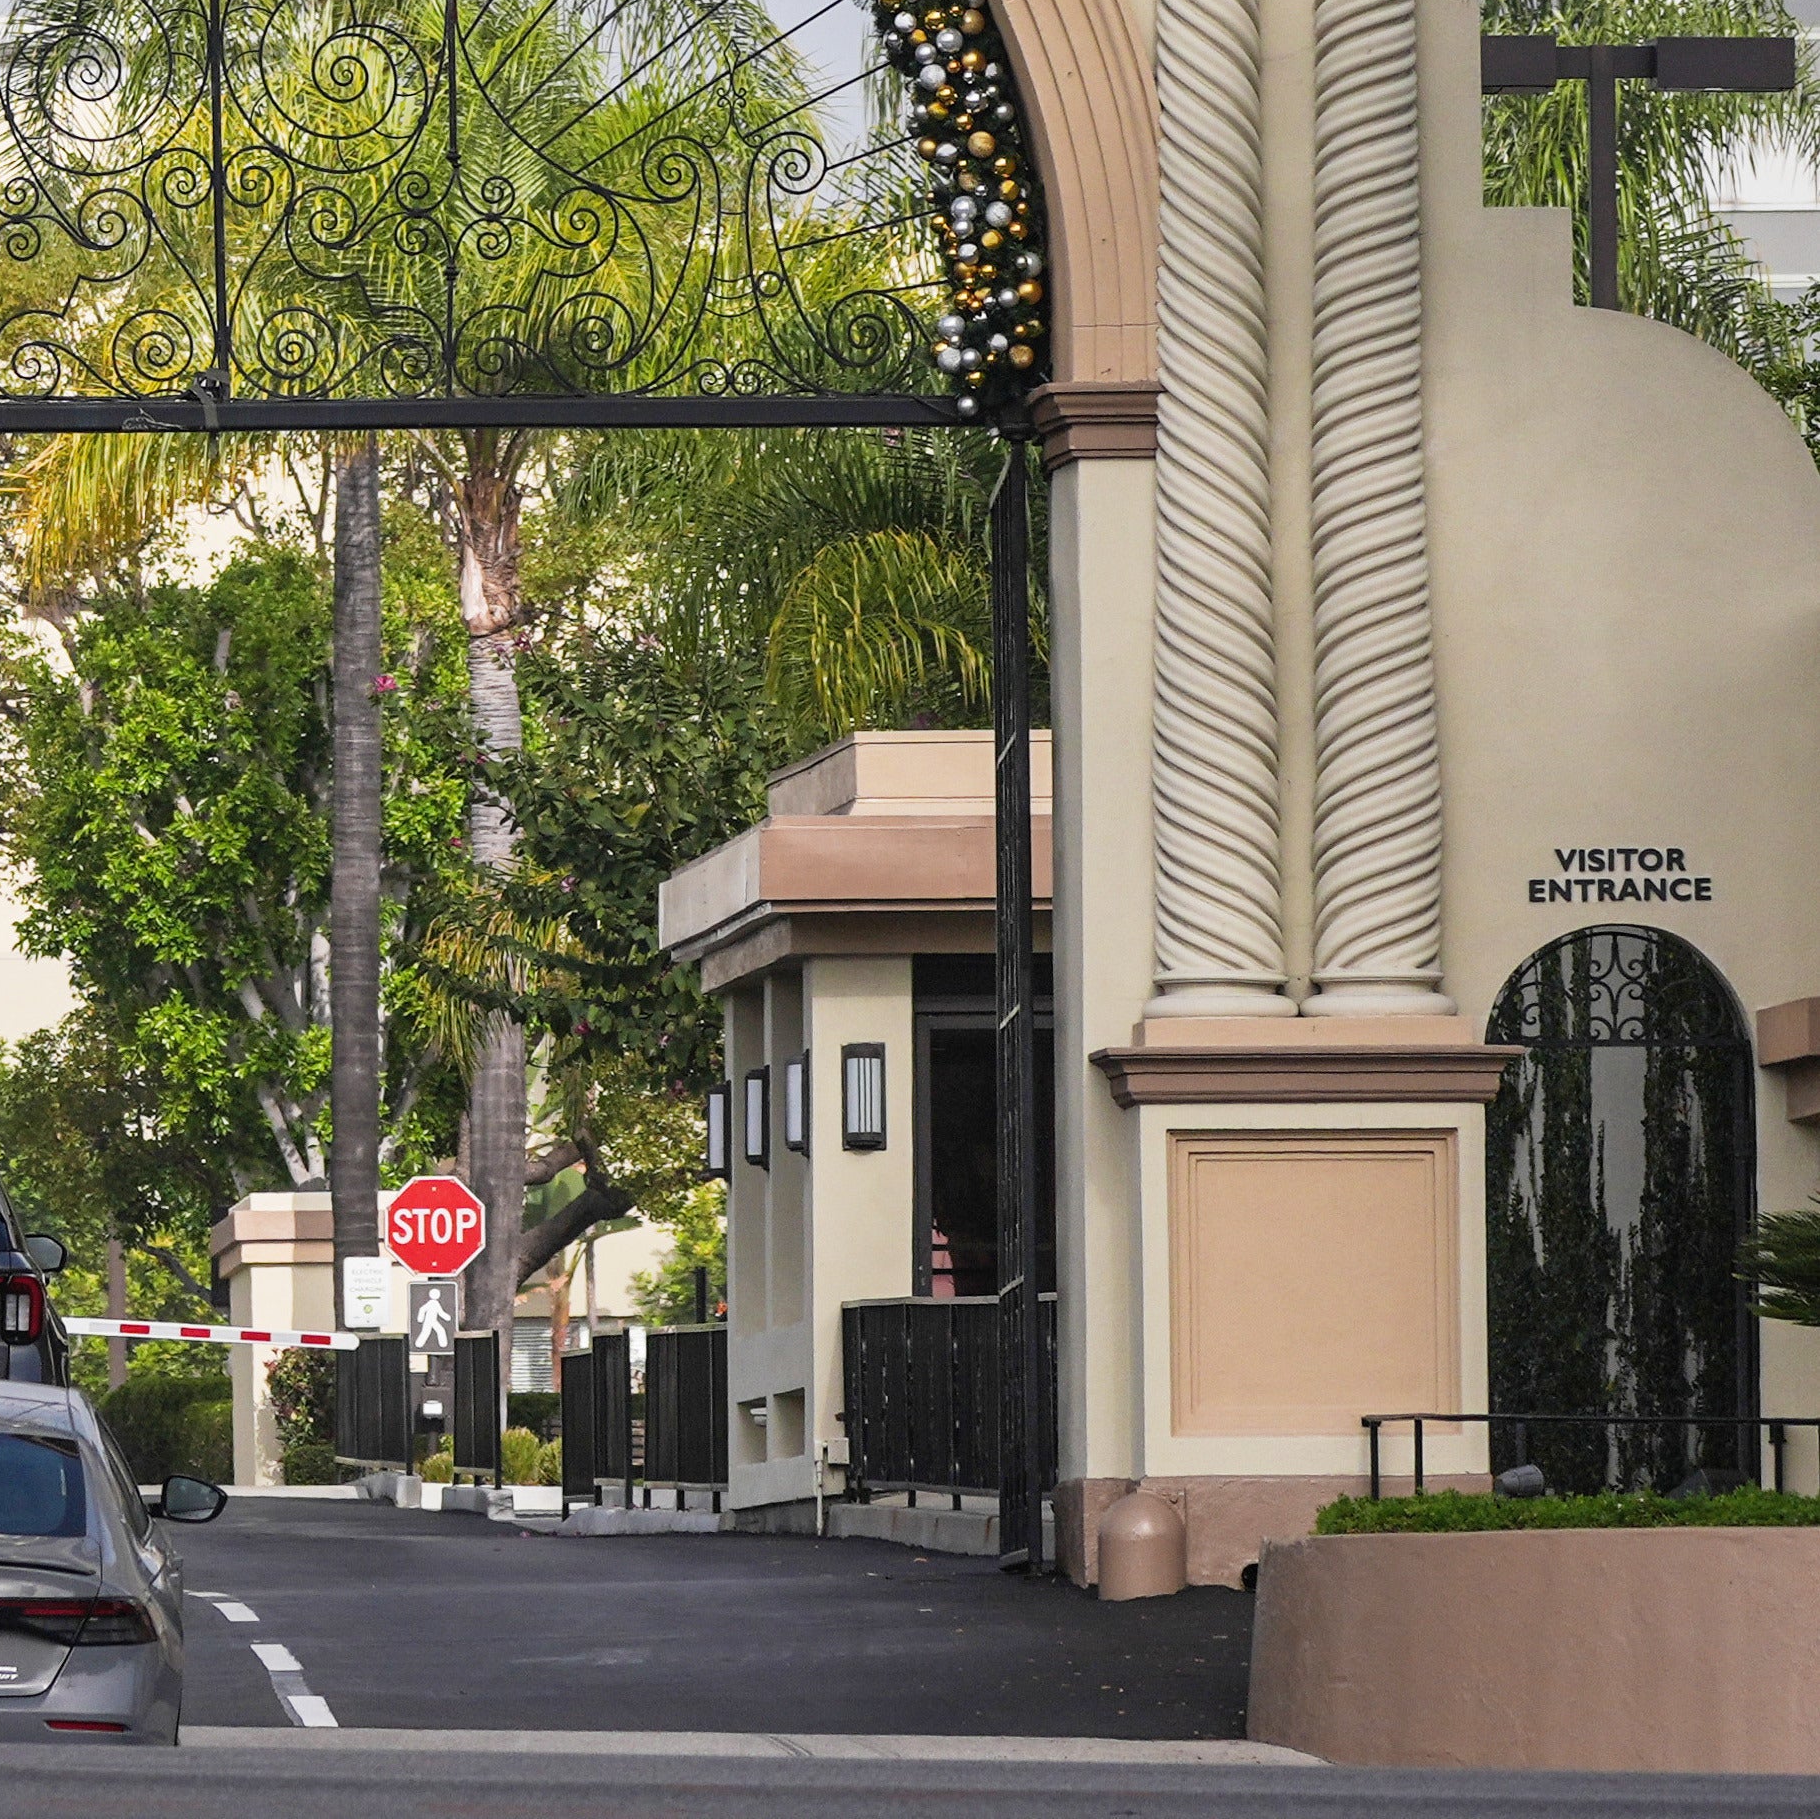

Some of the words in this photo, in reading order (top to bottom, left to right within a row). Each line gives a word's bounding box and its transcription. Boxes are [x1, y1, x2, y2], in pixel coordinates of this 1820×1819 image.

[1554, 848, 1686, 872] VISITOR
[1529, 878, 1712, 902] ENTRANCE
[392, 1207, 478, 1245] STOP
